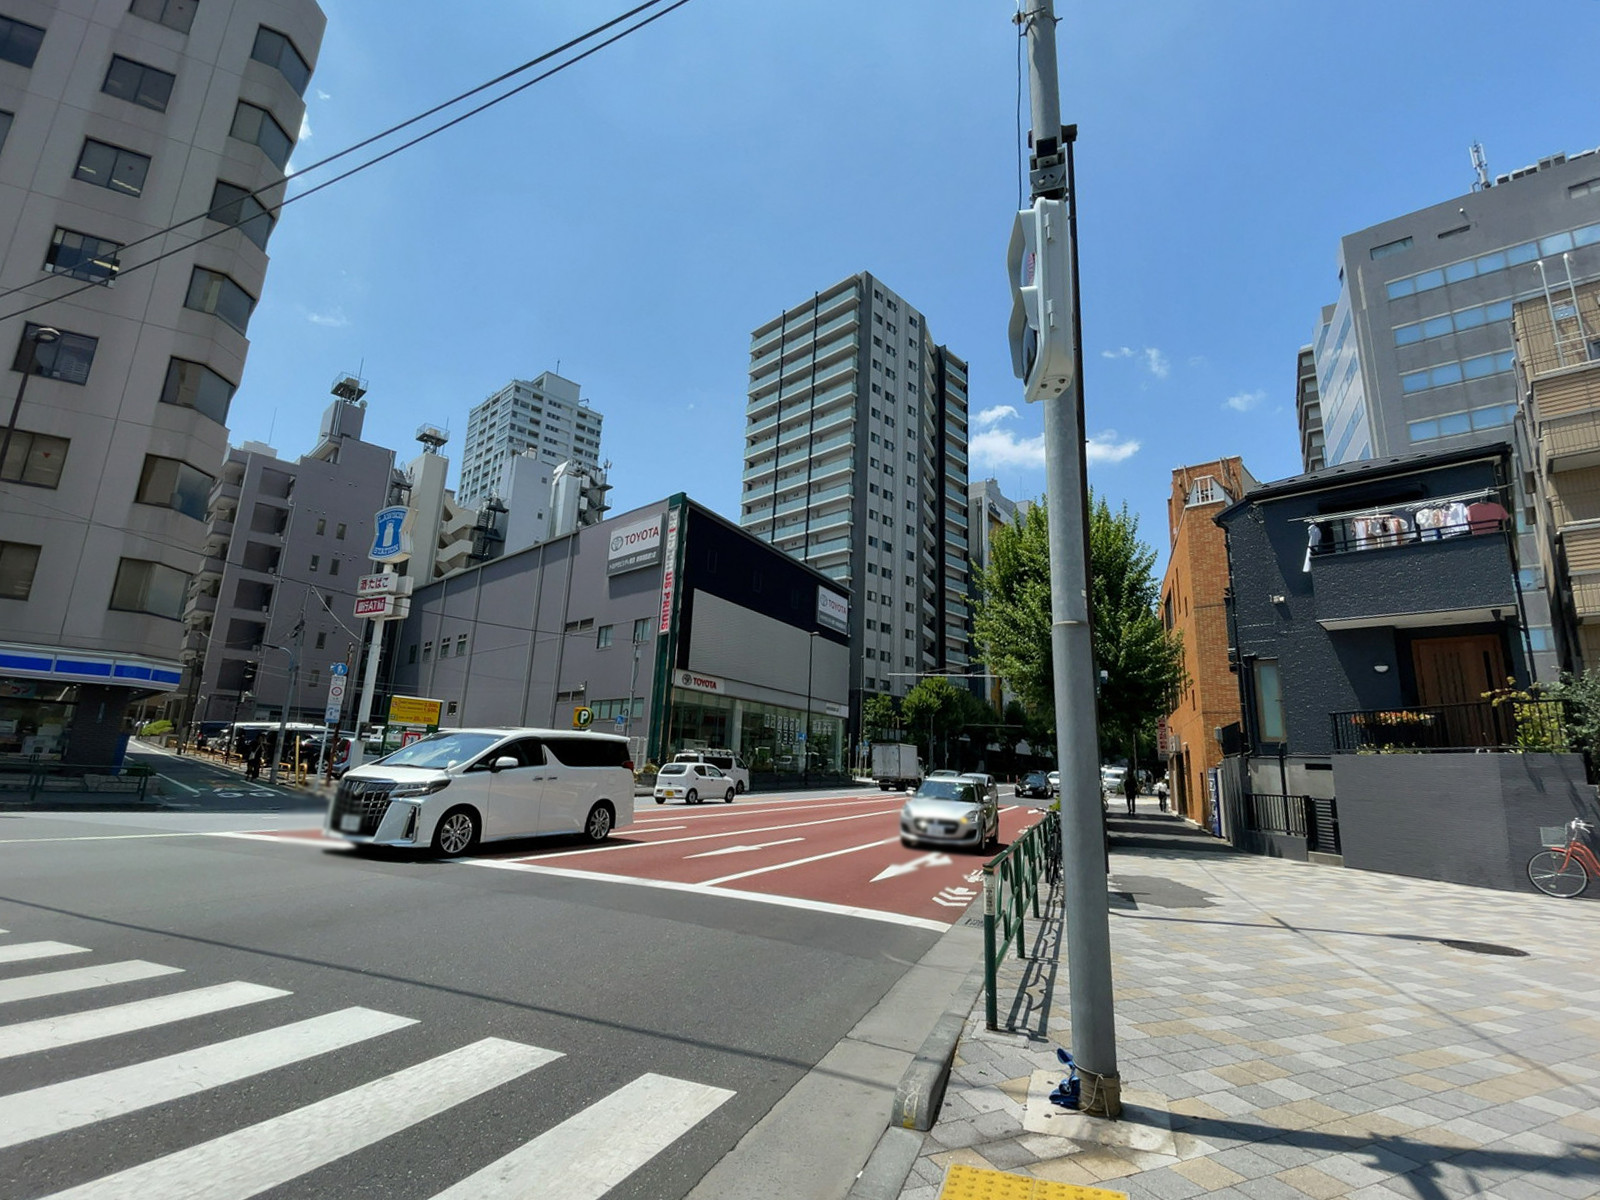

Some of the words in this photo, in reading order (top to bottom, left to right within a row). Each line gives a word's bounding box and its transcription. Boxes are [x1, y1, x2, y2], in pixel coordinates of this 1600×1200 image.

[625, 526, 659, 545] TOYOTA
[661, 591, 671, 629] PRIUS
[828, 599, 847, 614] TOYOTA
[693, 677, 717, 689] TOYOTA
[580, 710, 589, 724] P
